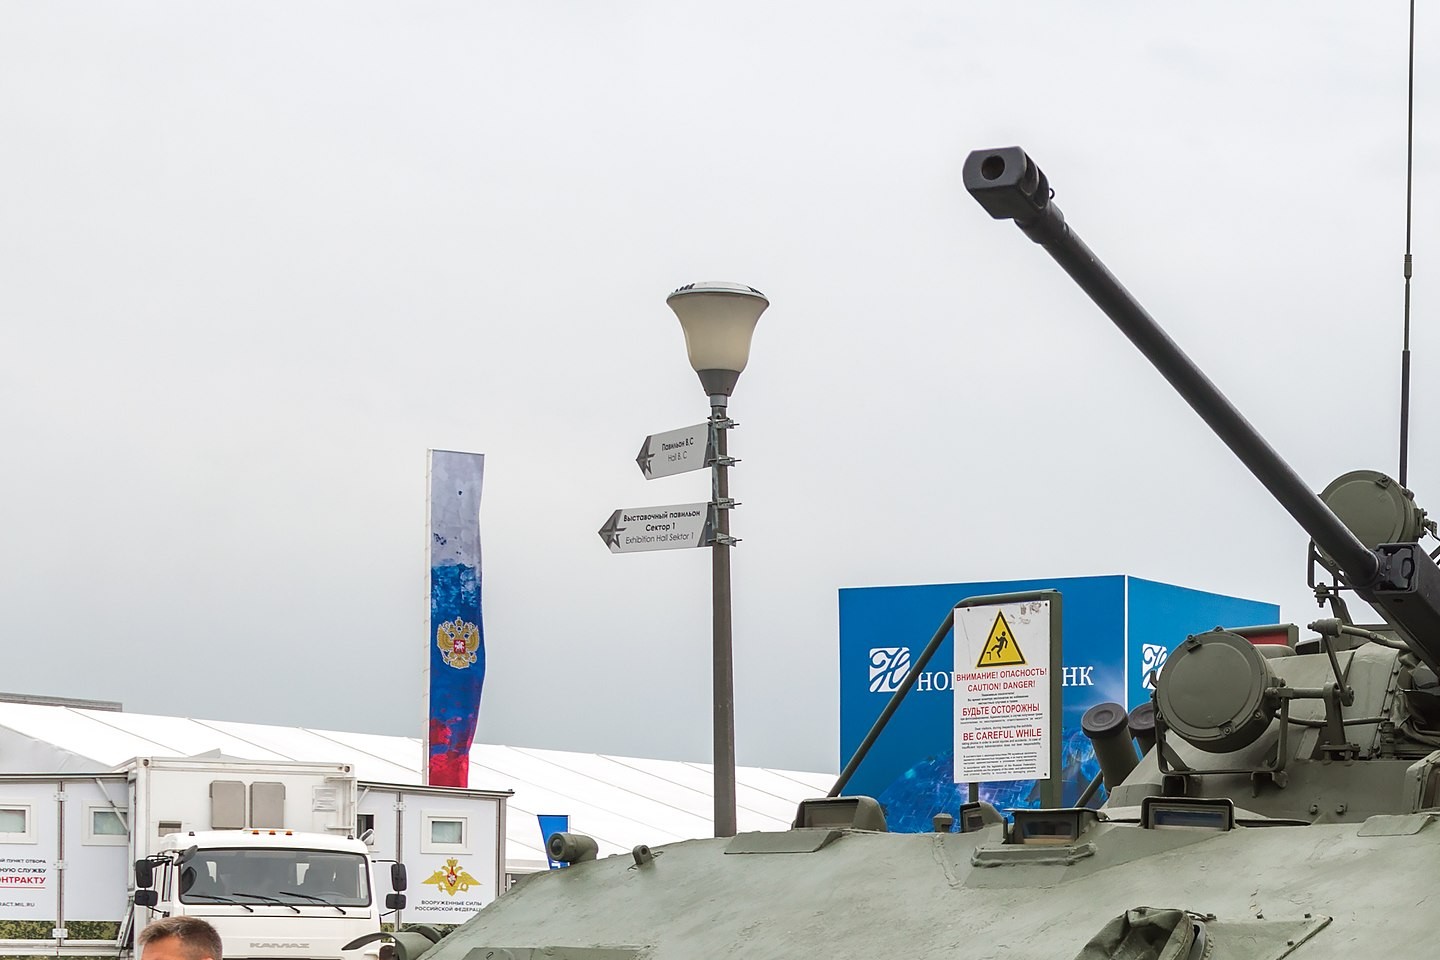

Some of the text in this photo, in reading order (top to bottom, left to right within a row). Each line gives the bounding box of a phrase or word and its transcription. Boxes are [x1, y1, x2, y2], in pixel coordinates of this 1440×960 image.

[623, 510, 701, 522] Выставочный павильон
[645, 524, 671, 532] Сектор
[625, 535, 655, 544] Exhibition
[656, 533, 668, 542] Hall
[669, 532, 689, 540] Sektor
[956, 668, 1047, 682] ВНИМАНИЕ! ОПАСНОСТЬ!
[967, 680, 1035, 692] CAUTION! DANGER!
[962, 706, 989, 717] БУДЬТЕ
[991, 703, 1040, 714] ОСТОРОЖНЫ
[963, 728, 1042, 741] BE CAREFUL WHILE
[0, 876, 46, 884] НТРАКТУ
